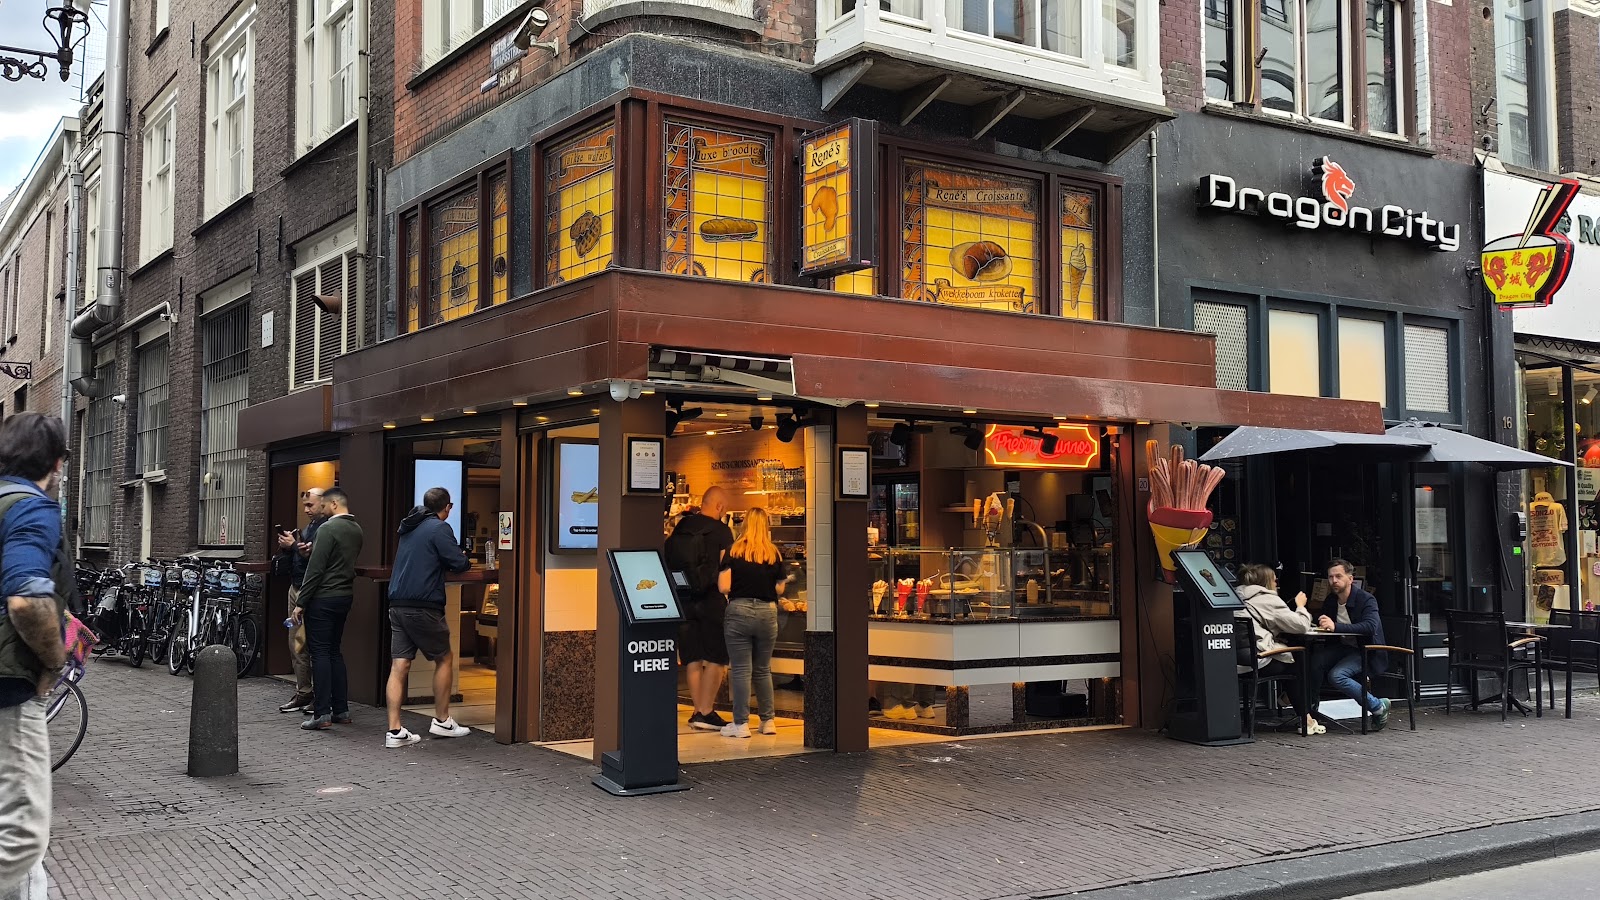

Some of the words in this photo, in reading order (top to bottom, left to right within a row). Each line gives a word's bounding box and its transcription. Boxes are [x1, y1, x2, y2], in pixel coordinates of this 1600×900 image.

[696, 150, 718, 161] luxe
[810, 142, 841, 168] René's
[936, 188, 967, 203] René's
[976, 190, 1024, 202] Croissants
[1209, 174, 1373, 232] Dragon
[1381, 204, 1460, 253] City
[1502, 416, 1512, 429] 16
[1139, 480, 1147, 489] 20
[1203, 623, 1234, 636] ORDER
[627, 639, 675, 654] ORDER
[1207, 638, 1231, 650] HERE
[633, 657, 670, 673] HERE
